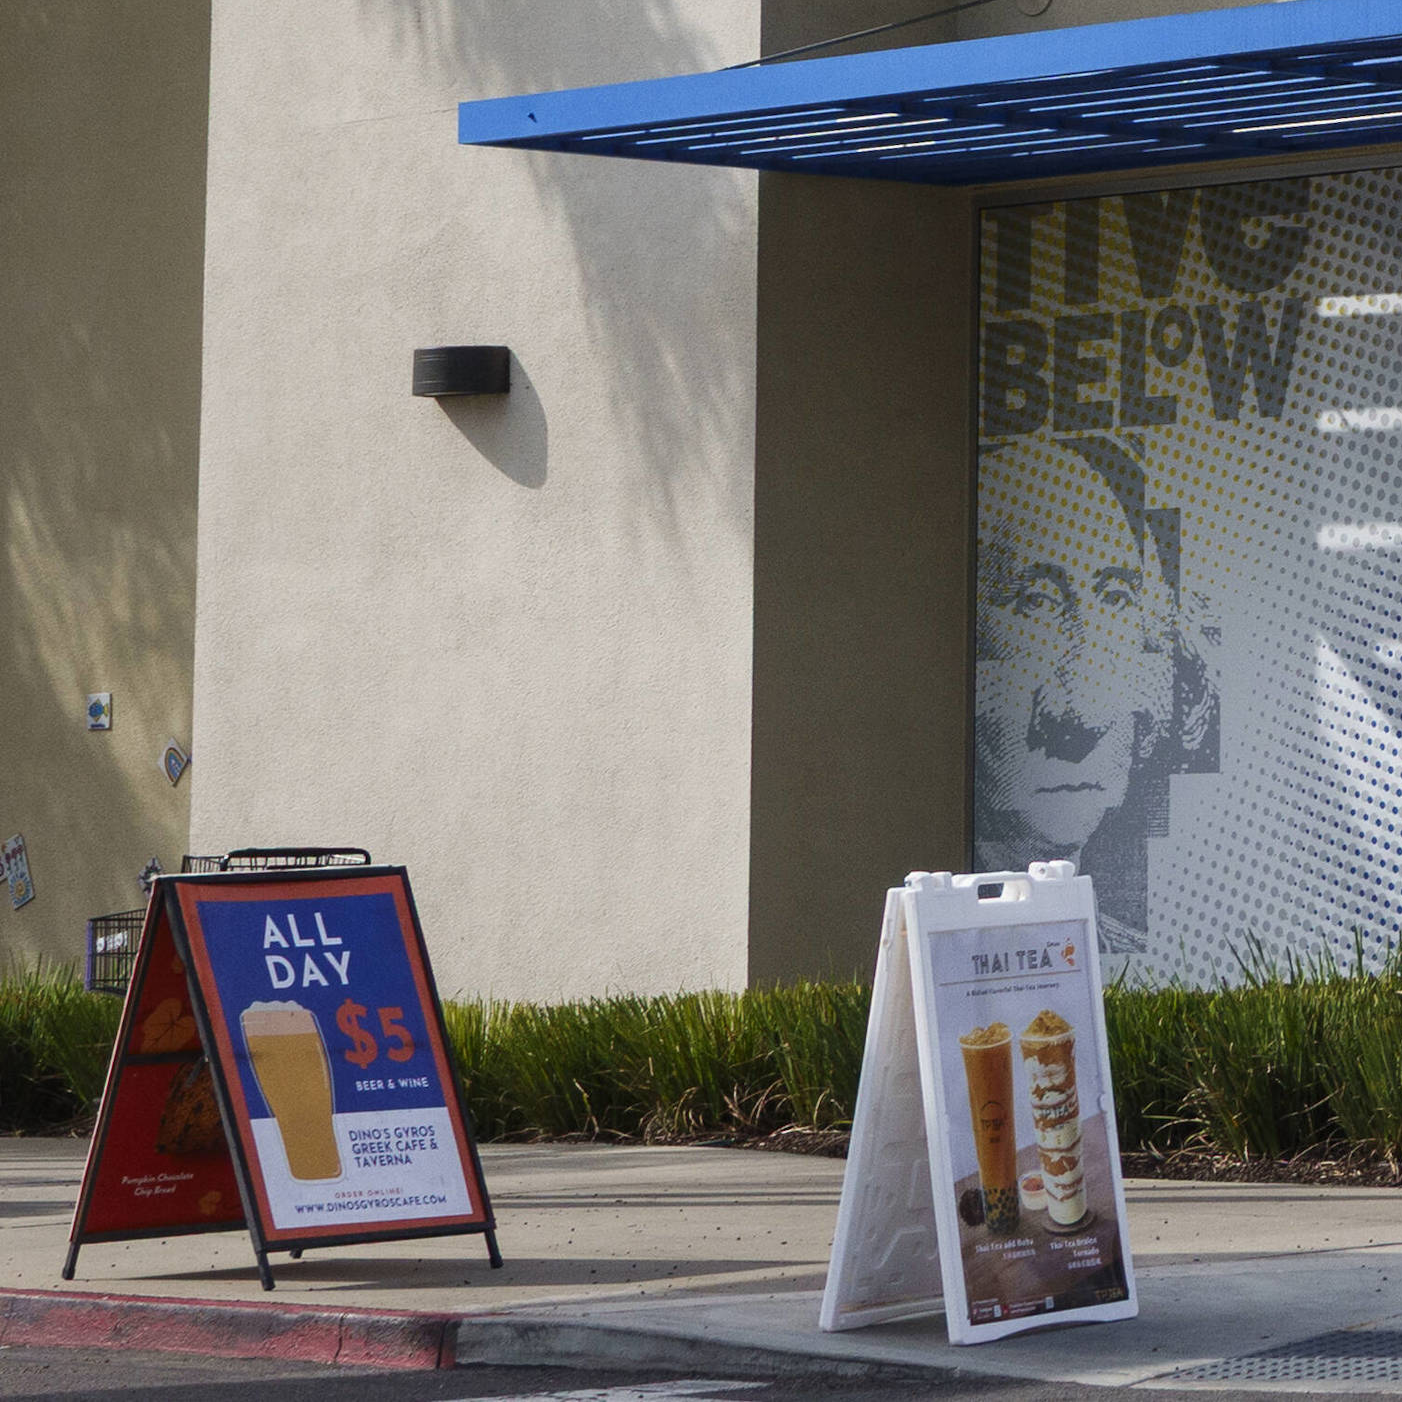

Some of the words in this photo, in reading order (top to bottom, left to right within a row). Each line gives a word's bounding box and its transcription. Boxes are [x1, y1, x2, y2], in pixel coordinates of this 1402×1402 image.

[984, 295, 1306, 436] BELOW
[263, 910, 343, 950] ALL
[264, 950, 352, 990] DAY
[971, 951, 1010, 975] THAI
[1015, 948, 1053, 970] TEA
[334, 998, 418, 1070] $5
[355, 1079, 385, 1093] BEER
[387, 1079, 396, 1090] &
[397, 1076, 430, 1089] WINE
[348, 1127, 391, 1142] DINO'S
[393, 1125, 436, 1139] GYROS
[351, 1140, 393, 1155] GREEK
[395, 1139, 427, 1152] CAFE
[429, 1138, 440, 1151] &
[354, 1153, 413, 1169] TAVERNA
[294, 1194, 448, 1214] WWW.DINOSGYROSCAFE.COM
[333, 1190, 364, 1199] ORDER
